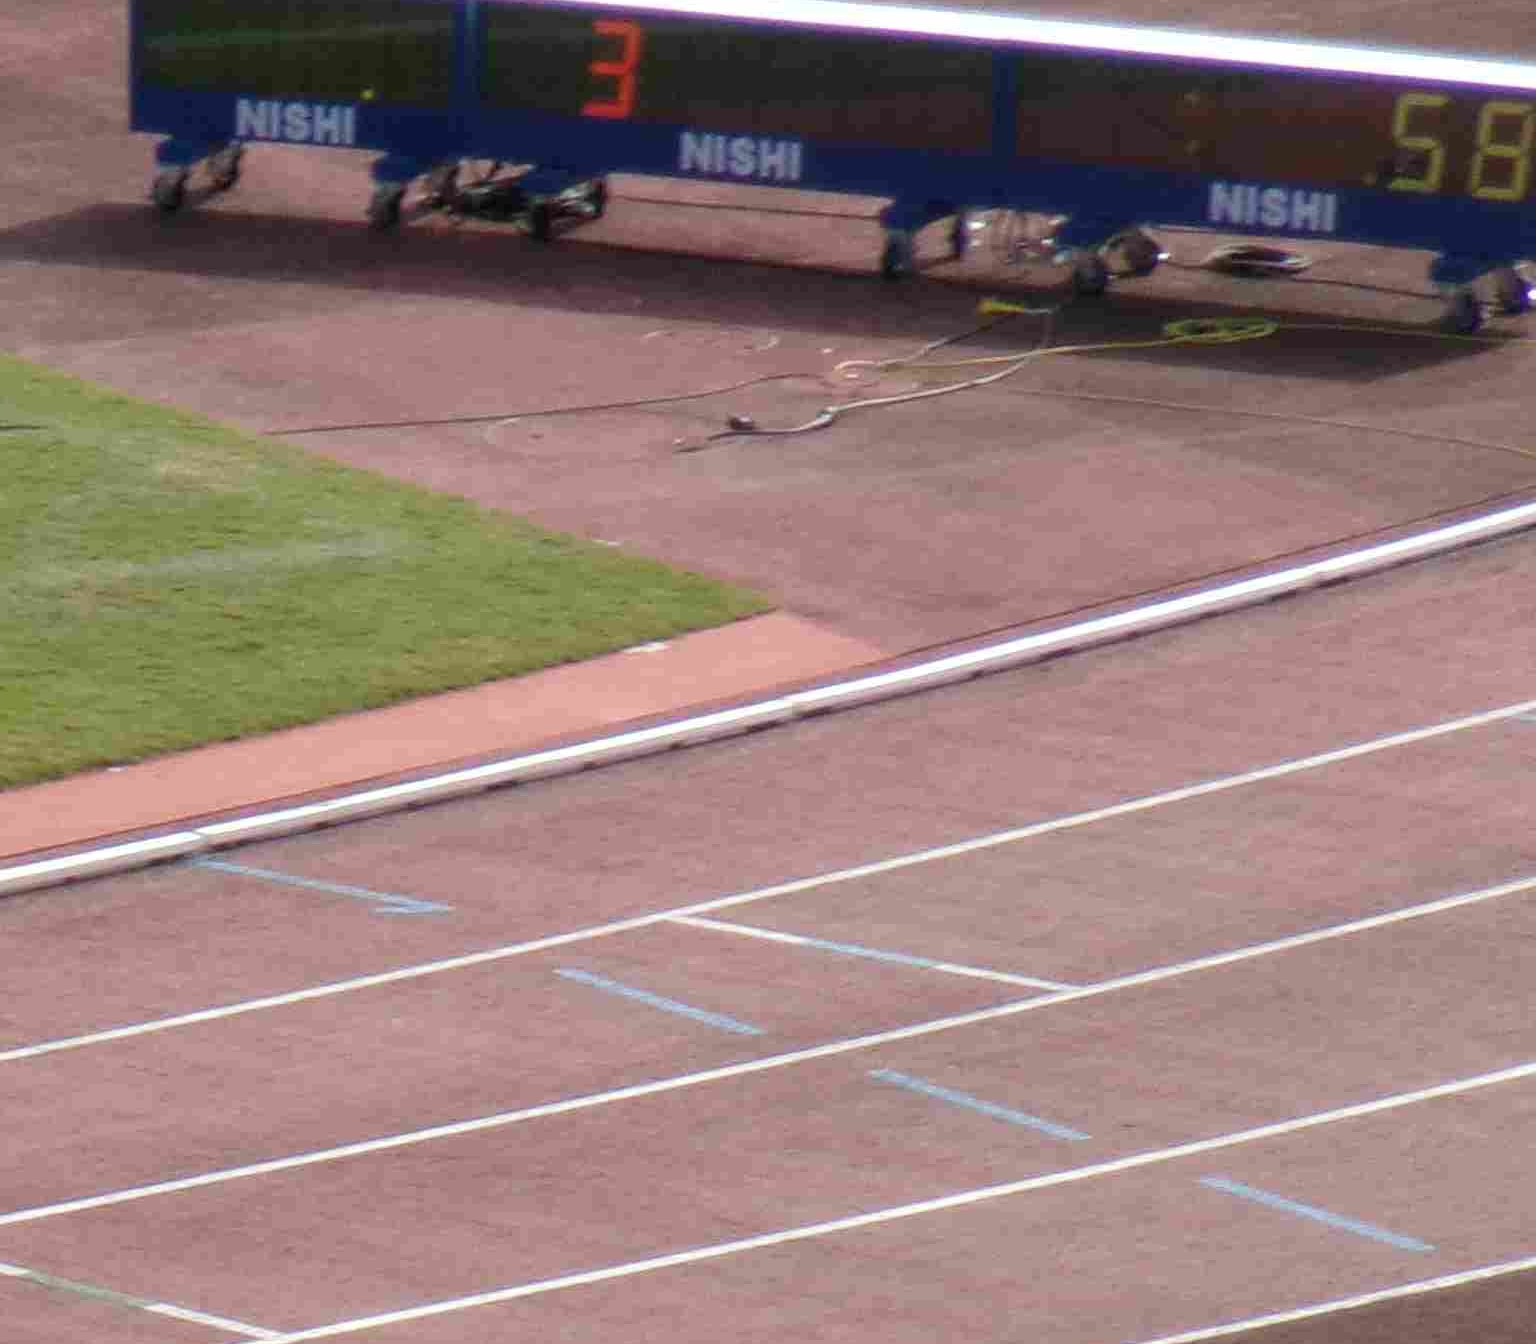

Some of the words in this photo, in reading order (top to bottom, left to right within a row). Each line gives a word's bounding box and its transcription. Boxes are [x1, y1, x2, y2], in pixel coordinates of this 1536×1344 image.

[581, 19, 642, 119] 3
[235, 98, 357, 146] NISHI
[1387, 92, 1535, 200] 58
[678, 131, 802, 181] NISHI
[1207, 181, 1337, 232] NISHI
